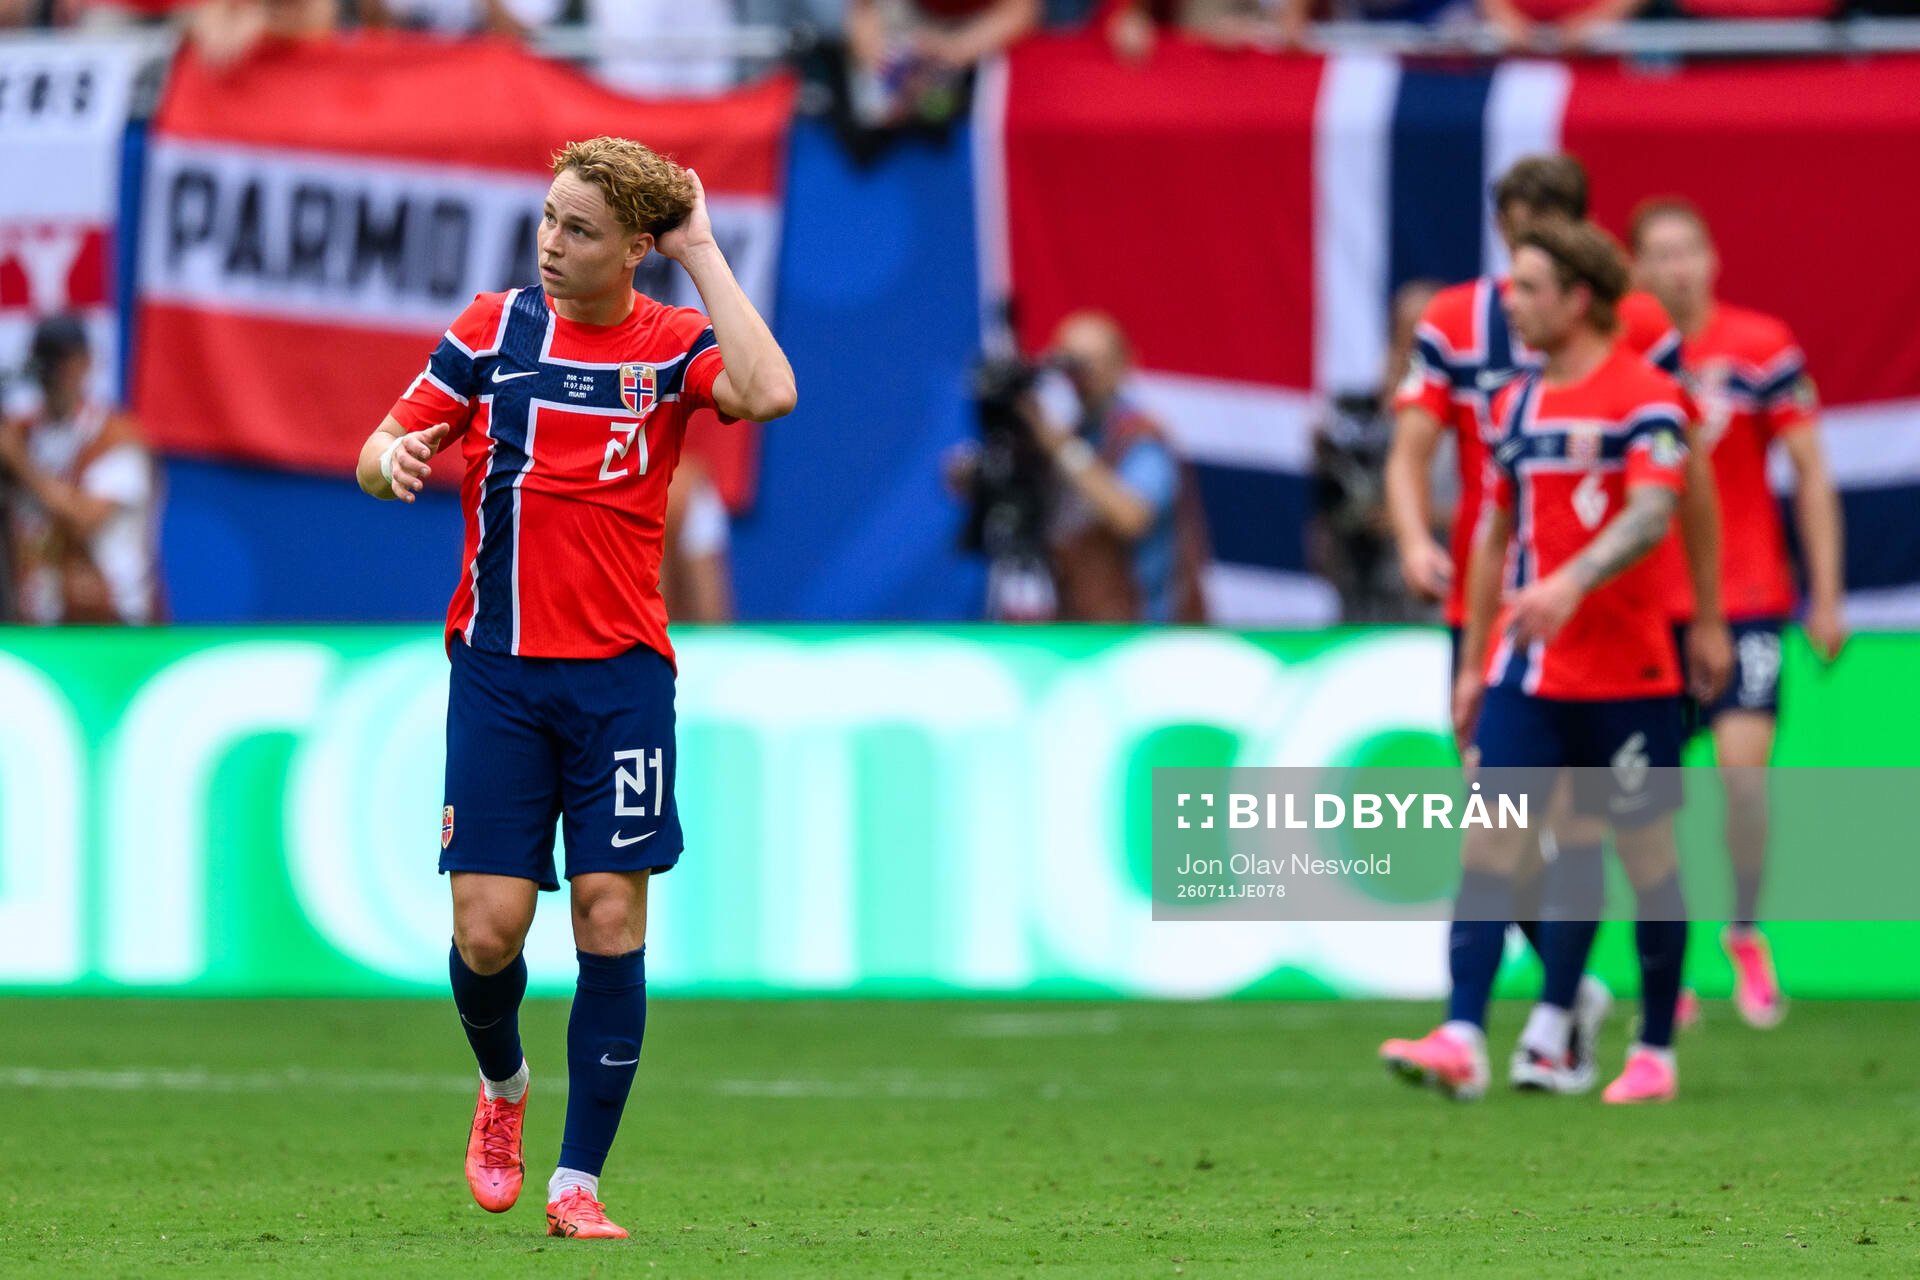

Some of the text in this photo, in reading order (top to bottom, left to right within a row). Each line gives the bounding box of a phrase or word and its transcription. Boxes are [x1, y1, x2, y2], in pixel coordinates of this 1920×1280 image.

[598, 421, 649, 481] 21
[614, 748, 663, 816] 21
[1610, 731, 1650, 793] 6
